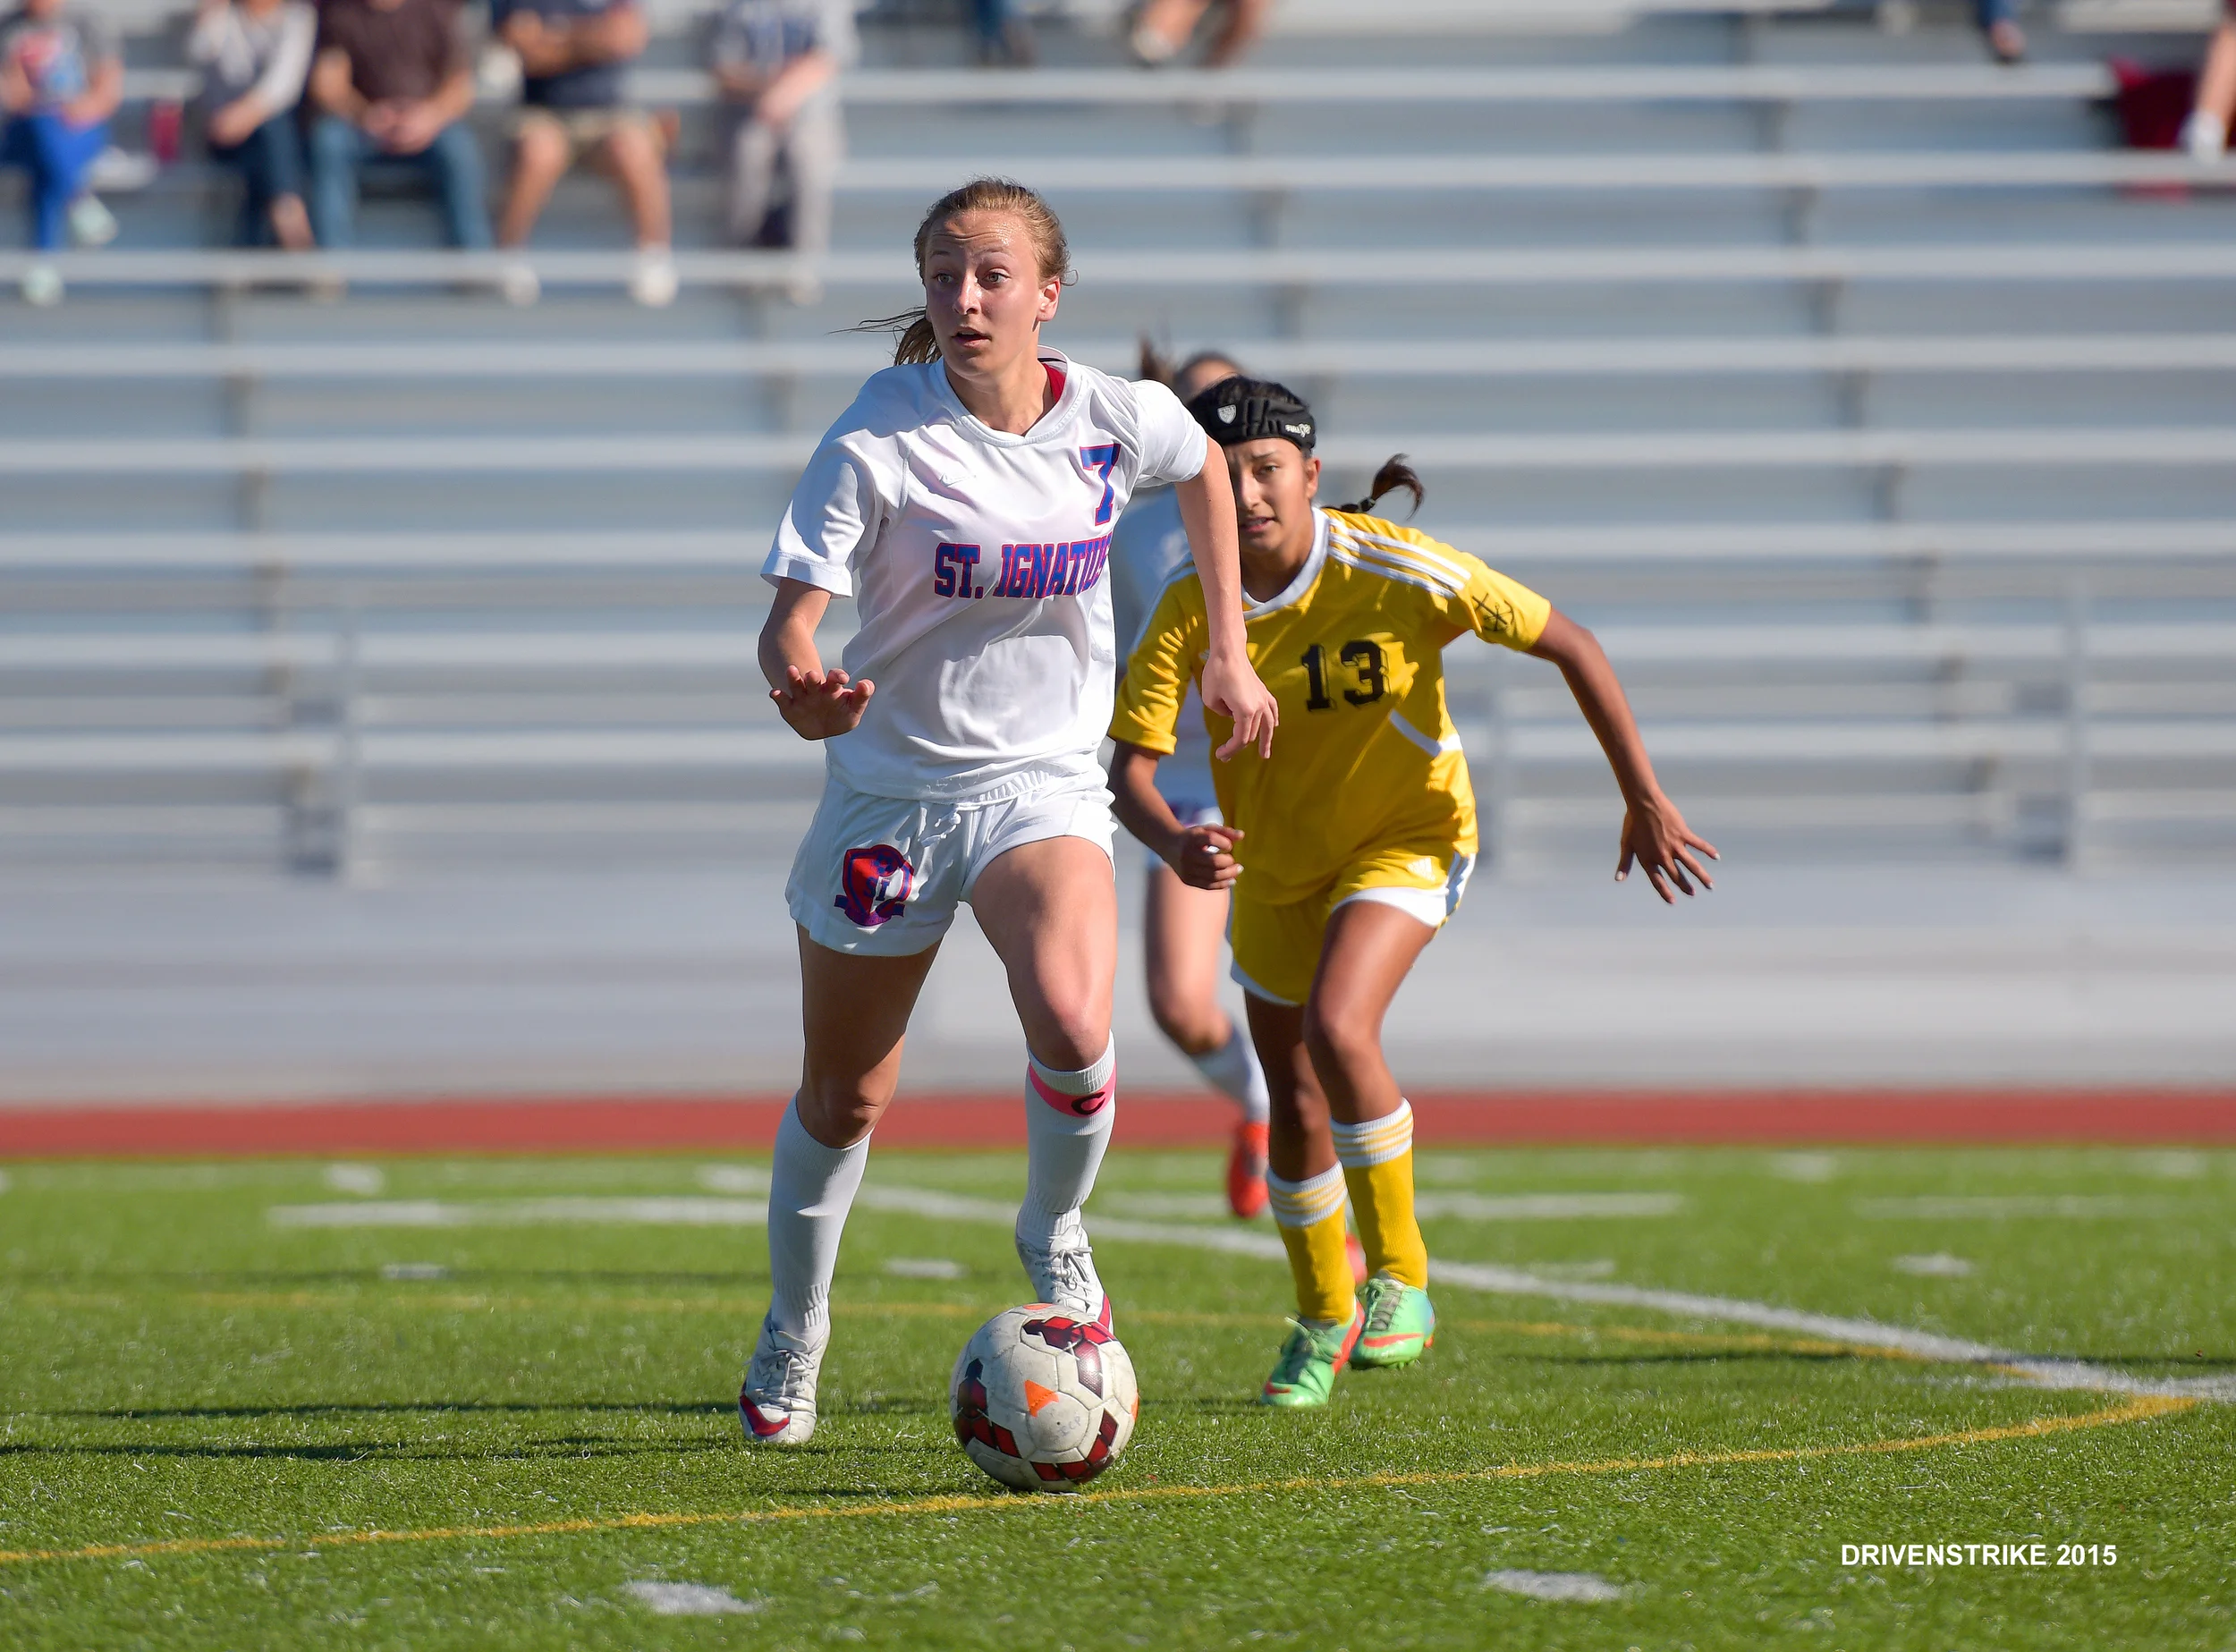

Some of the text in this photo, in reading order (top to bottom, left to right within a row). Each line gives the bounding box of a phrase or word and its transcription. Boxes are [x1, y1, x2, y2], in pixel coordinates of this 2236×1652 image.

[1079, 443, 1122, 526] 7
[934, 542, 983, 598] ST.
[1301, 640, 1391, 712] 13
